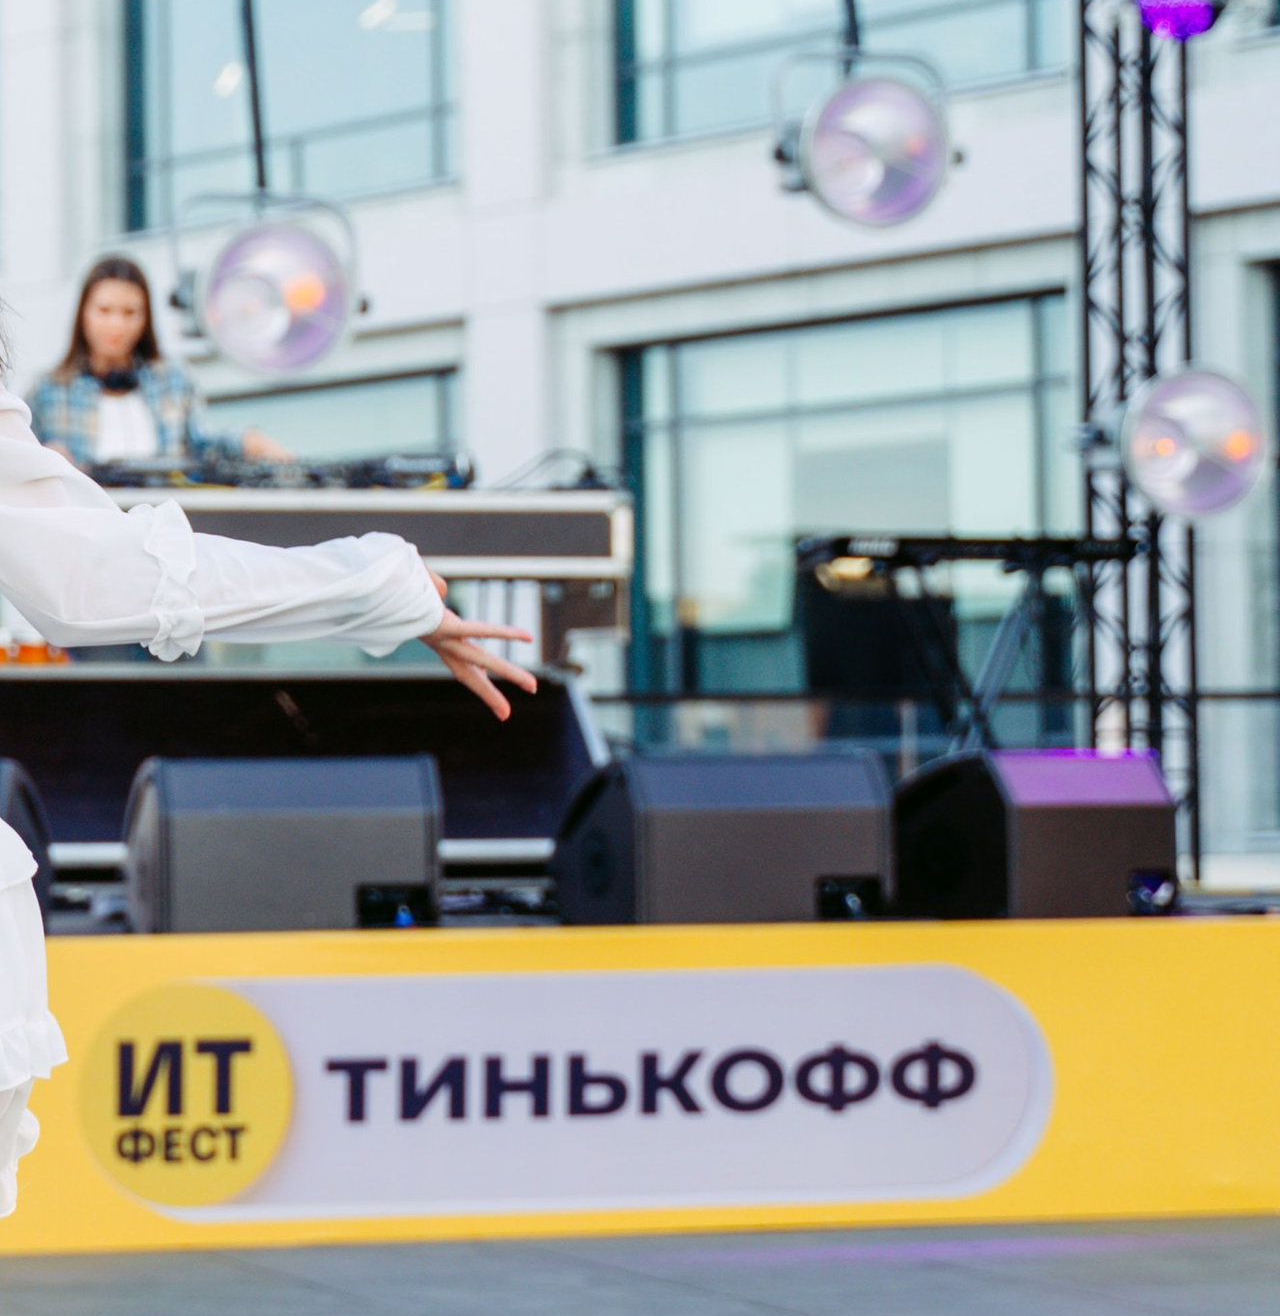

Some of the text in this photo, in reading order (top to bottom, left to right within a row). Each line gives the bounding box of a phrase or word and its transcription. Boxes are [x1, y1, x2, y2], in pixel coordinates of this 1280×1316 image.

[116, 1037, 253, 1118] ИТ
[325, 1039, 977, 1124] ТИНЬКОФФ
[116, 1124, 246, 1165] ФЕСТ
